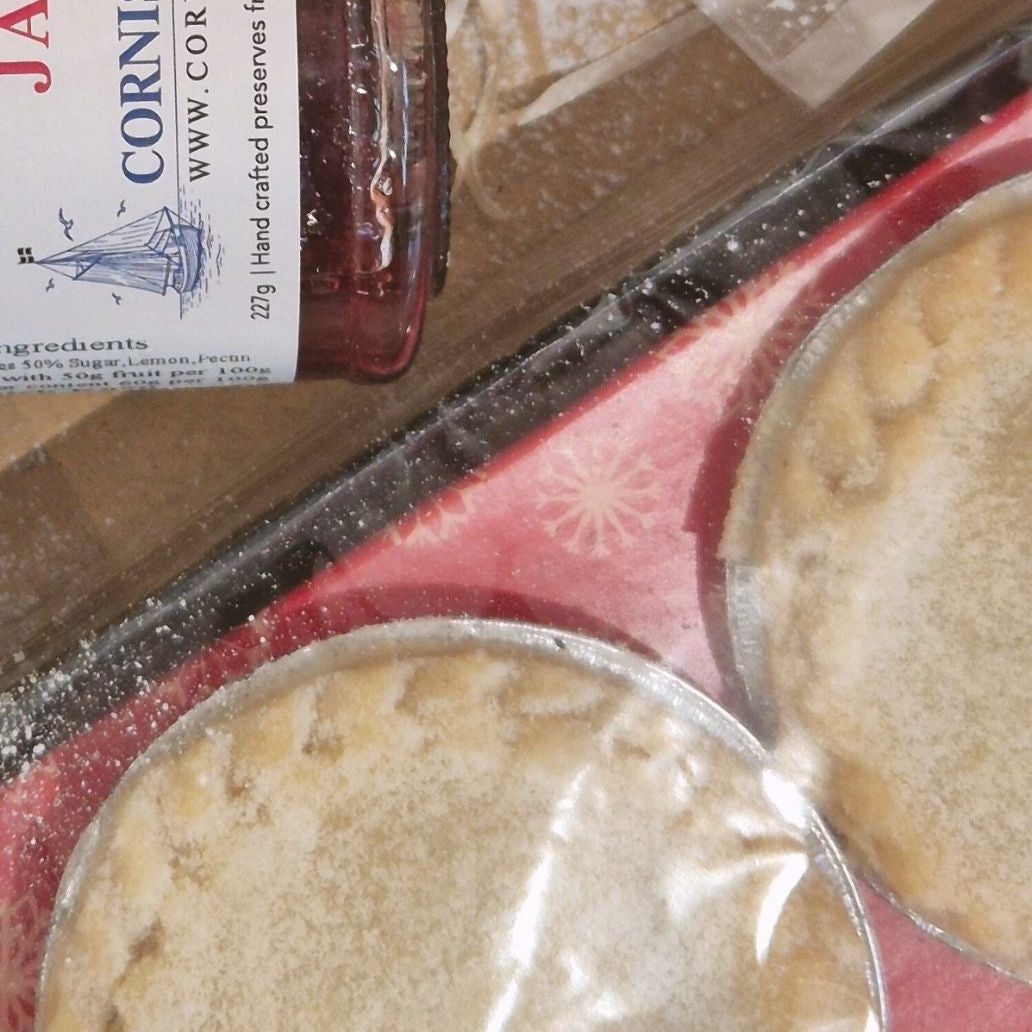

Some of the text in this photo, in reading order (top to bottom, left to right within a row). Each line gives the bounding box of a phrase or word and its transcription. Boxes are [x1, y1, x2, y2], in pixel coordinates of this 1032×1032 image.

[252, 19, 275, 130] preserves
[248, 137, 271, 209] crafted
[249, 217, 272, 266] Hand
[250, 284, 277, 320] 227g
[1, 372, 54, 383] with
[61, 371, 104, 382] 50g
[111, 368, 162, 379] fruit
[169, 368, 207, 379] per
[22, 357, 65, 370] 50%
